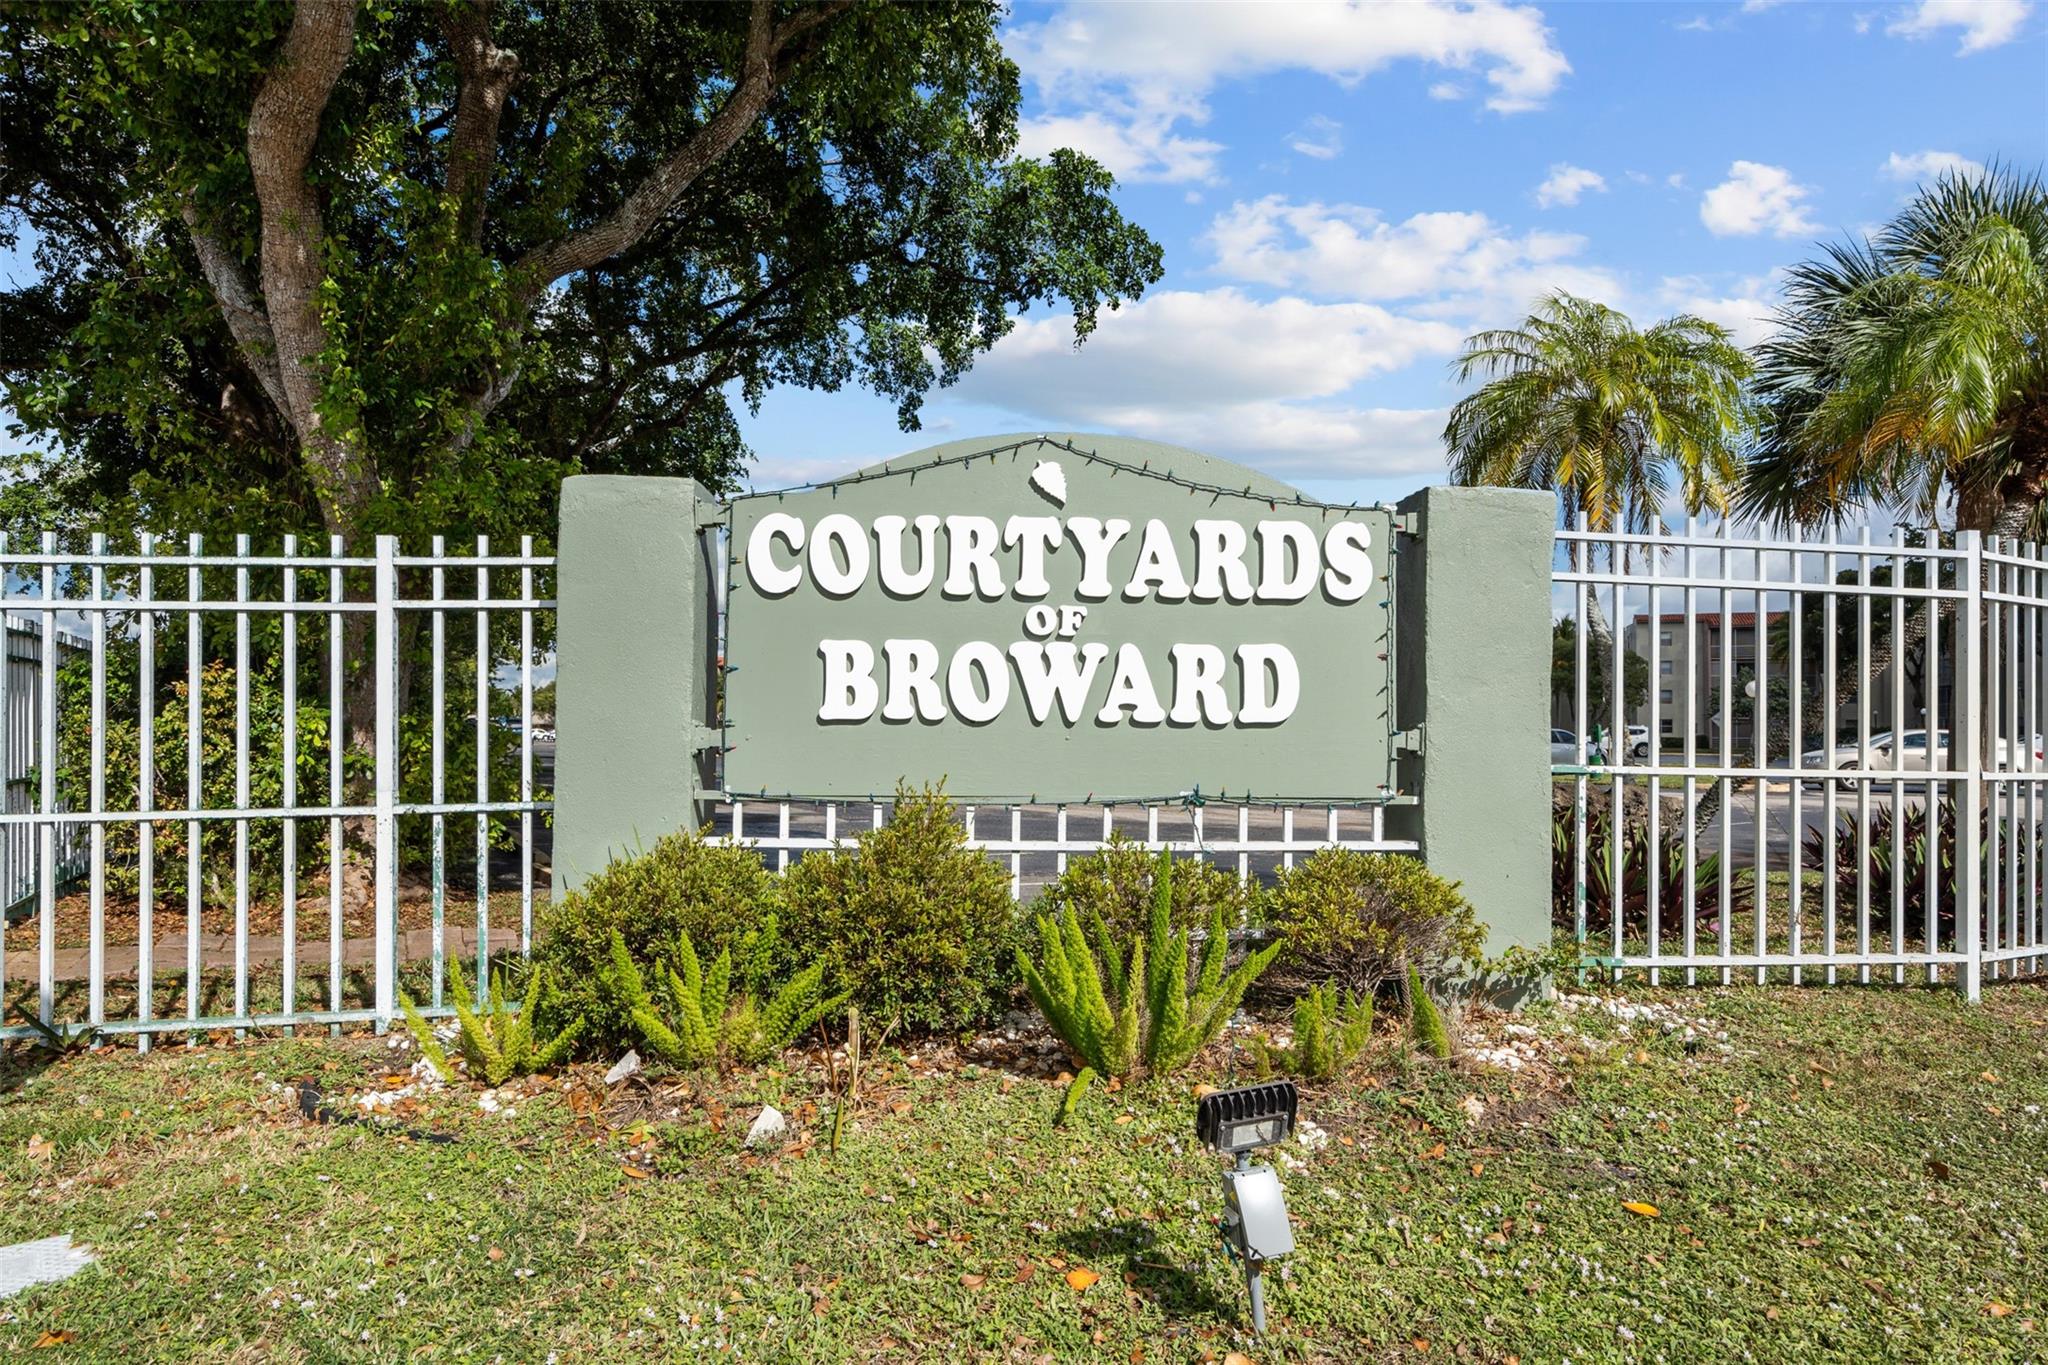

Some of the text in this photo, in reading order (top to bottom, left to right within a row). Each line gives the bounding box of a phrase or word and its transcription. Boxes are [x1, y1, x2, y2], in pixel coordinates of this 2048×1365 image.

[747, 512, 1374, 601] COURTYARDS
[1024, 604, 1088, 637] OF
[818, 638, 1300, 725] BROWARD
